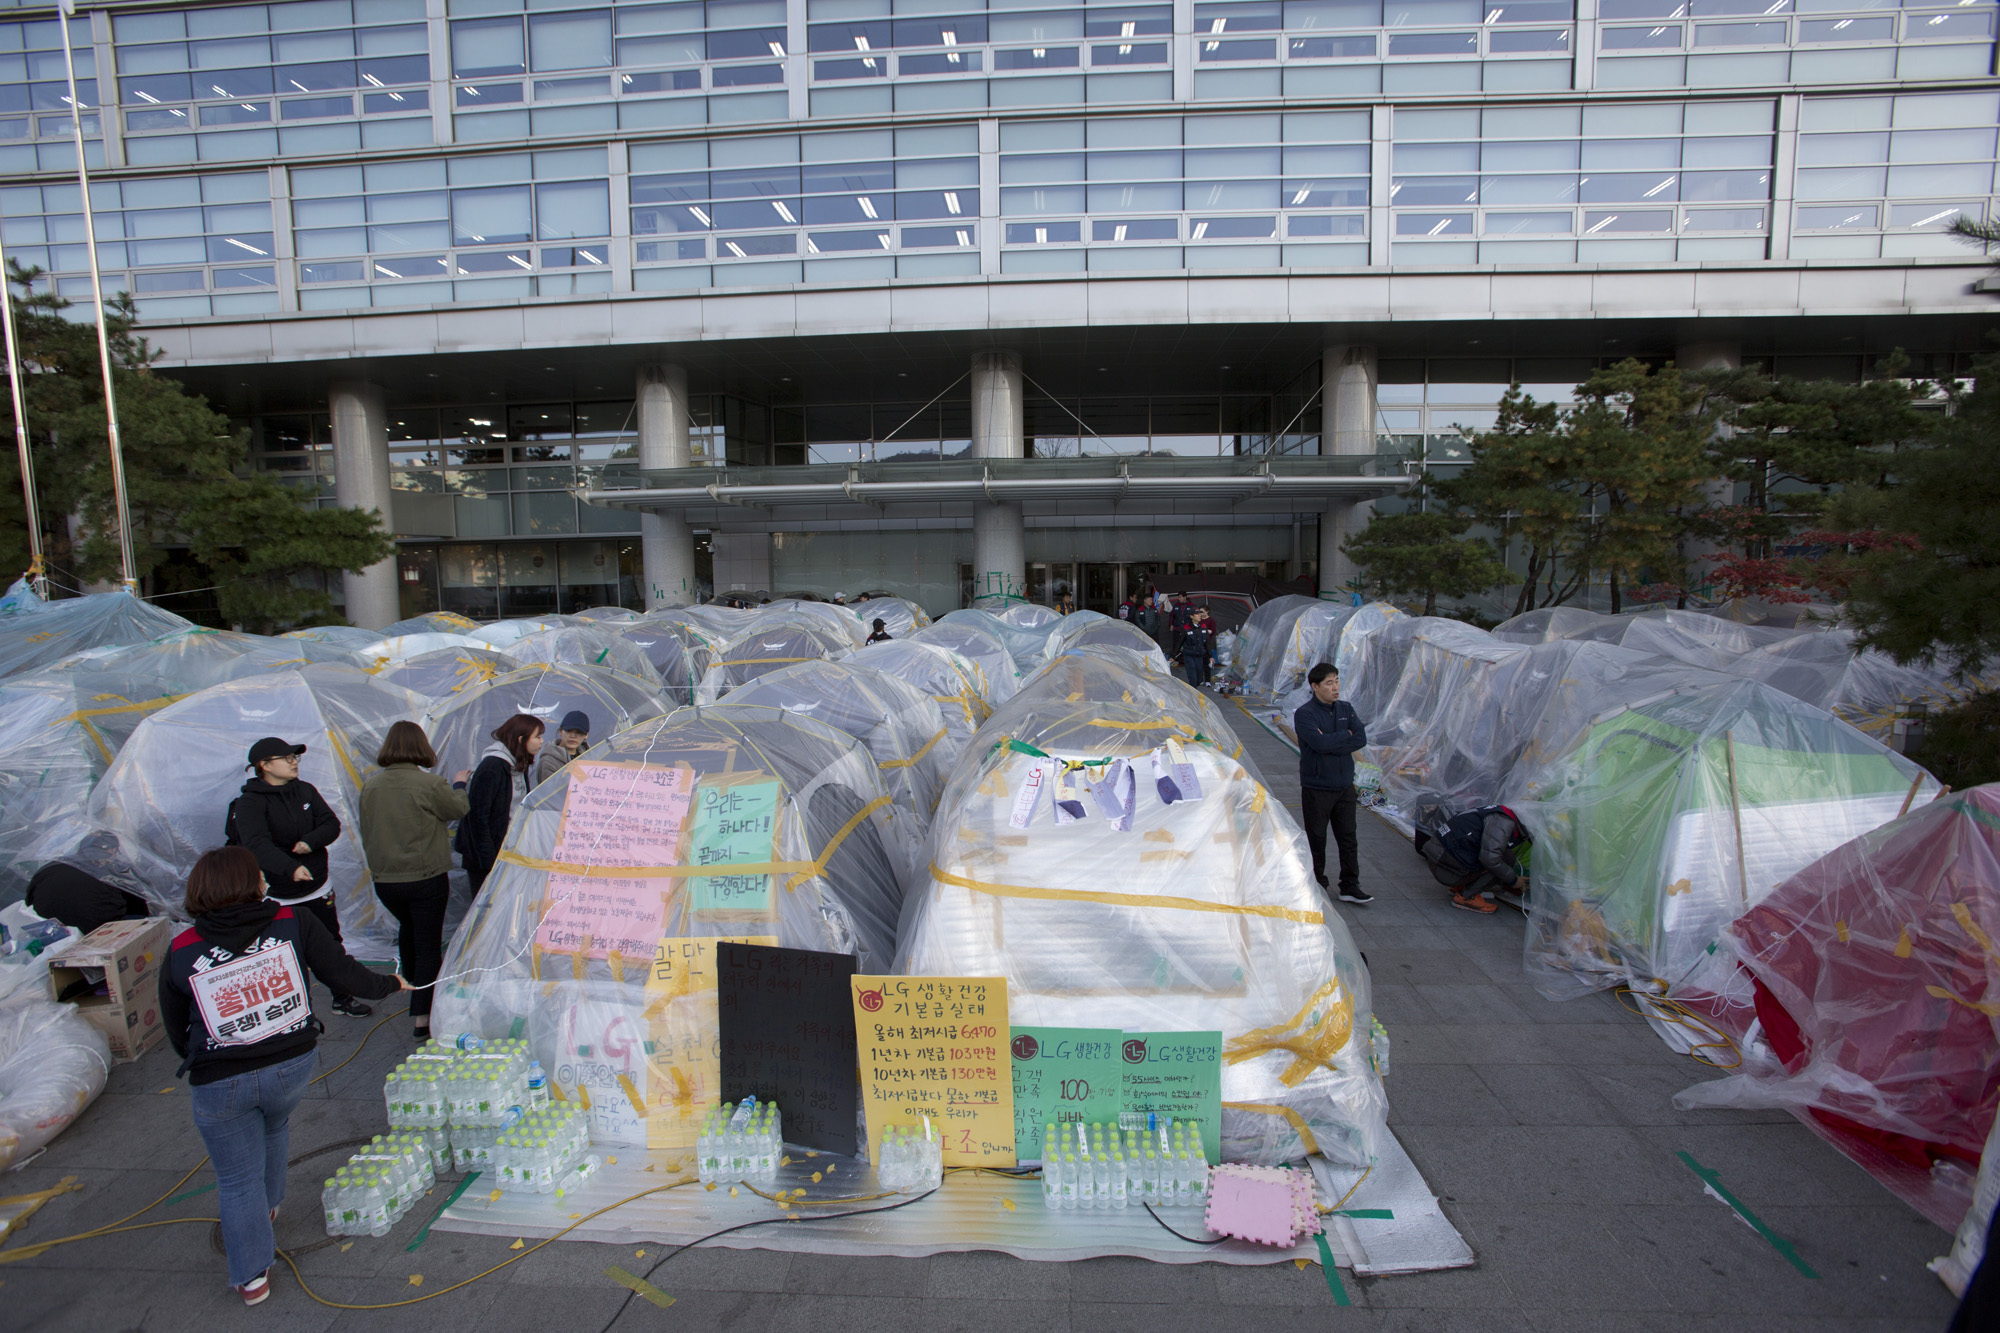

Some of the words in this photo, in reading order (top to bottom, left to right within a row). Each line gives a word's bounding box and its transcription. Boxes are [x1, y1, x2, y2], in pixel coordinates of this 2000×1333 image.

[703, 791, 744, 818] 우리는
[719, 816, 771, 834] 하나다!
[699, 845, 732, 865] 끝까지
[728, 948, 763, 972] LG
[214, 968, 295, 1018] 총파업
[883, 982, 910, 998] LG
[917, 982, 988, 1001] 생활건강
[217, 1011, 262, 1037] 투쟁!
[265, 993, 302, 1021] 승리!
[874, 1024, 904, 1042] 올해
[910, 1025, 958, 1040] 최저시급
[871, 1048, 910, 1063] 1년차
[916, 1047, 945, 1061] 기본급
[949, 1046, 996, 1061] 103만원
[874, 1068, 916, 1083] 10년차
[919, 1068, 948, 1081] 기본급
[951, 1067, 997, 1081] 130만원
[872, 1085, 942, 1102] 최저시급보다
[946, 1087, 969, 1104] 못한
[974, 1090, 999, 1103] 기본급
[945, 1106, 979, 1119] 우리가
[982, 1141, 1013, 1156] 입니까
